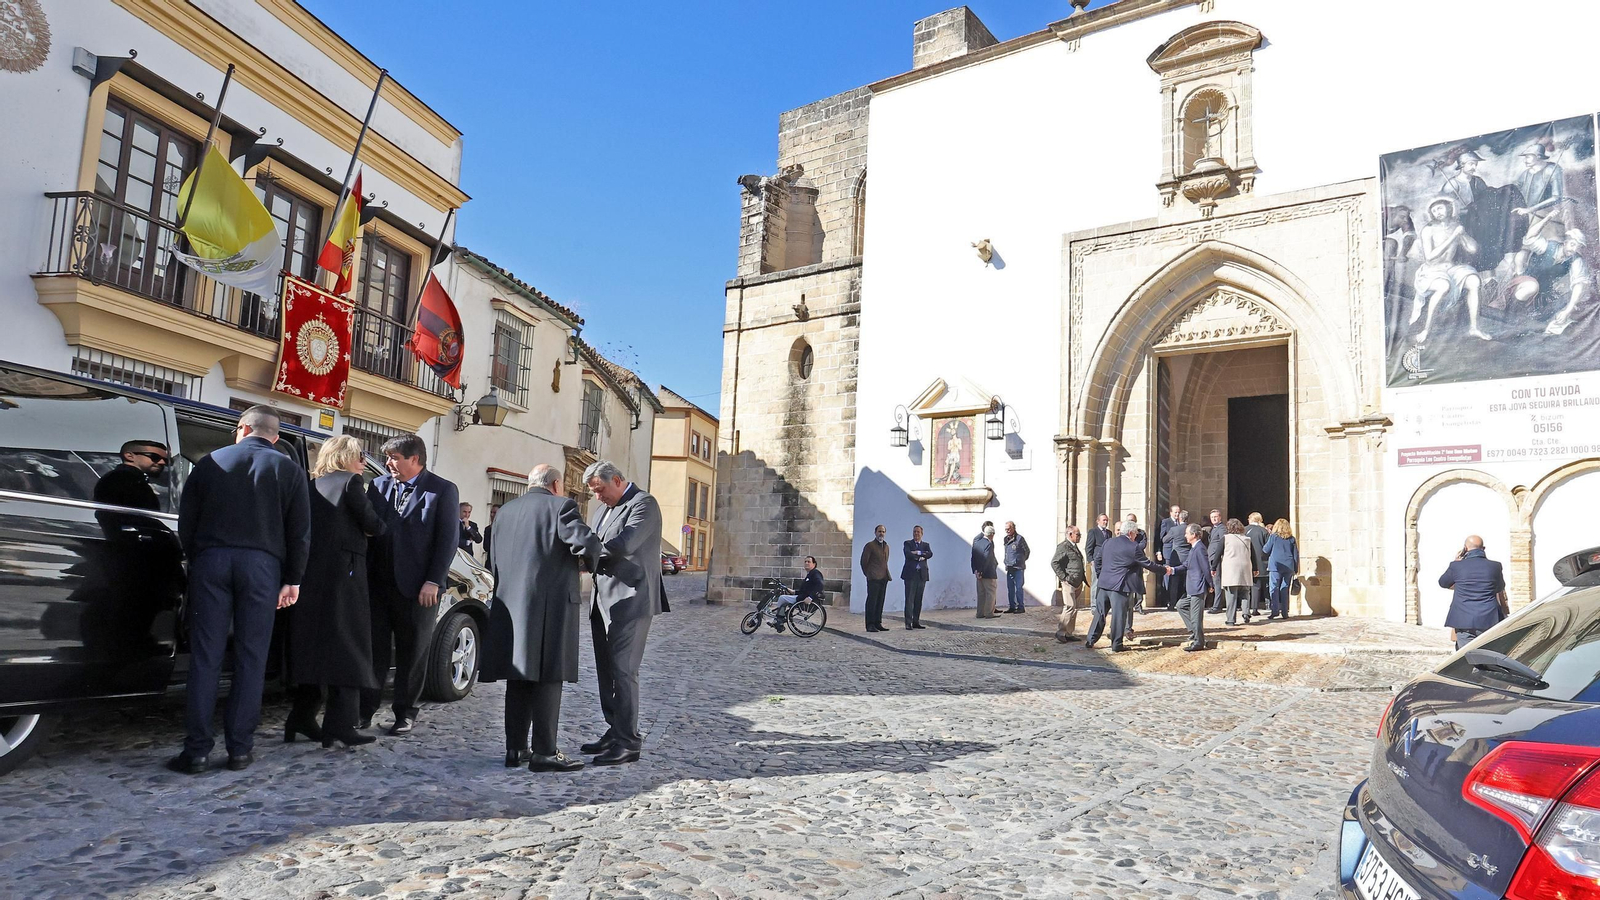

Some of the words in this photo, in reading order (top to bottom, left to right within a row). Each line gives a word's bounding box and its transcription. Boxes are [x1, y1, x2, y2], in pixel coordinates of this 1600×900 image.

[1511, 388, 1531, 400] CON
[1534, 387, 1546, 398] TU
[1549, 384, 1581, 397] AYUDA
[1489, 403, 1507, 412] ESTA
[1509, 402, 1527, 411] JOYA
[1540, 413, 1565, 421] bizum
[1533, 422, 1563, 433] 05156
[1486, 449, 1505, 458] ES77
[1506, 448, 1527, 457] 0049
[1529, 447, 1549, 456] 7323
[1550, 446, 1569, 455] 2821
[1570, 445, 1589, 454] 1000
[1466, 852, 1499, 877] C4
[1359, 850, 1389, 900] 3753
